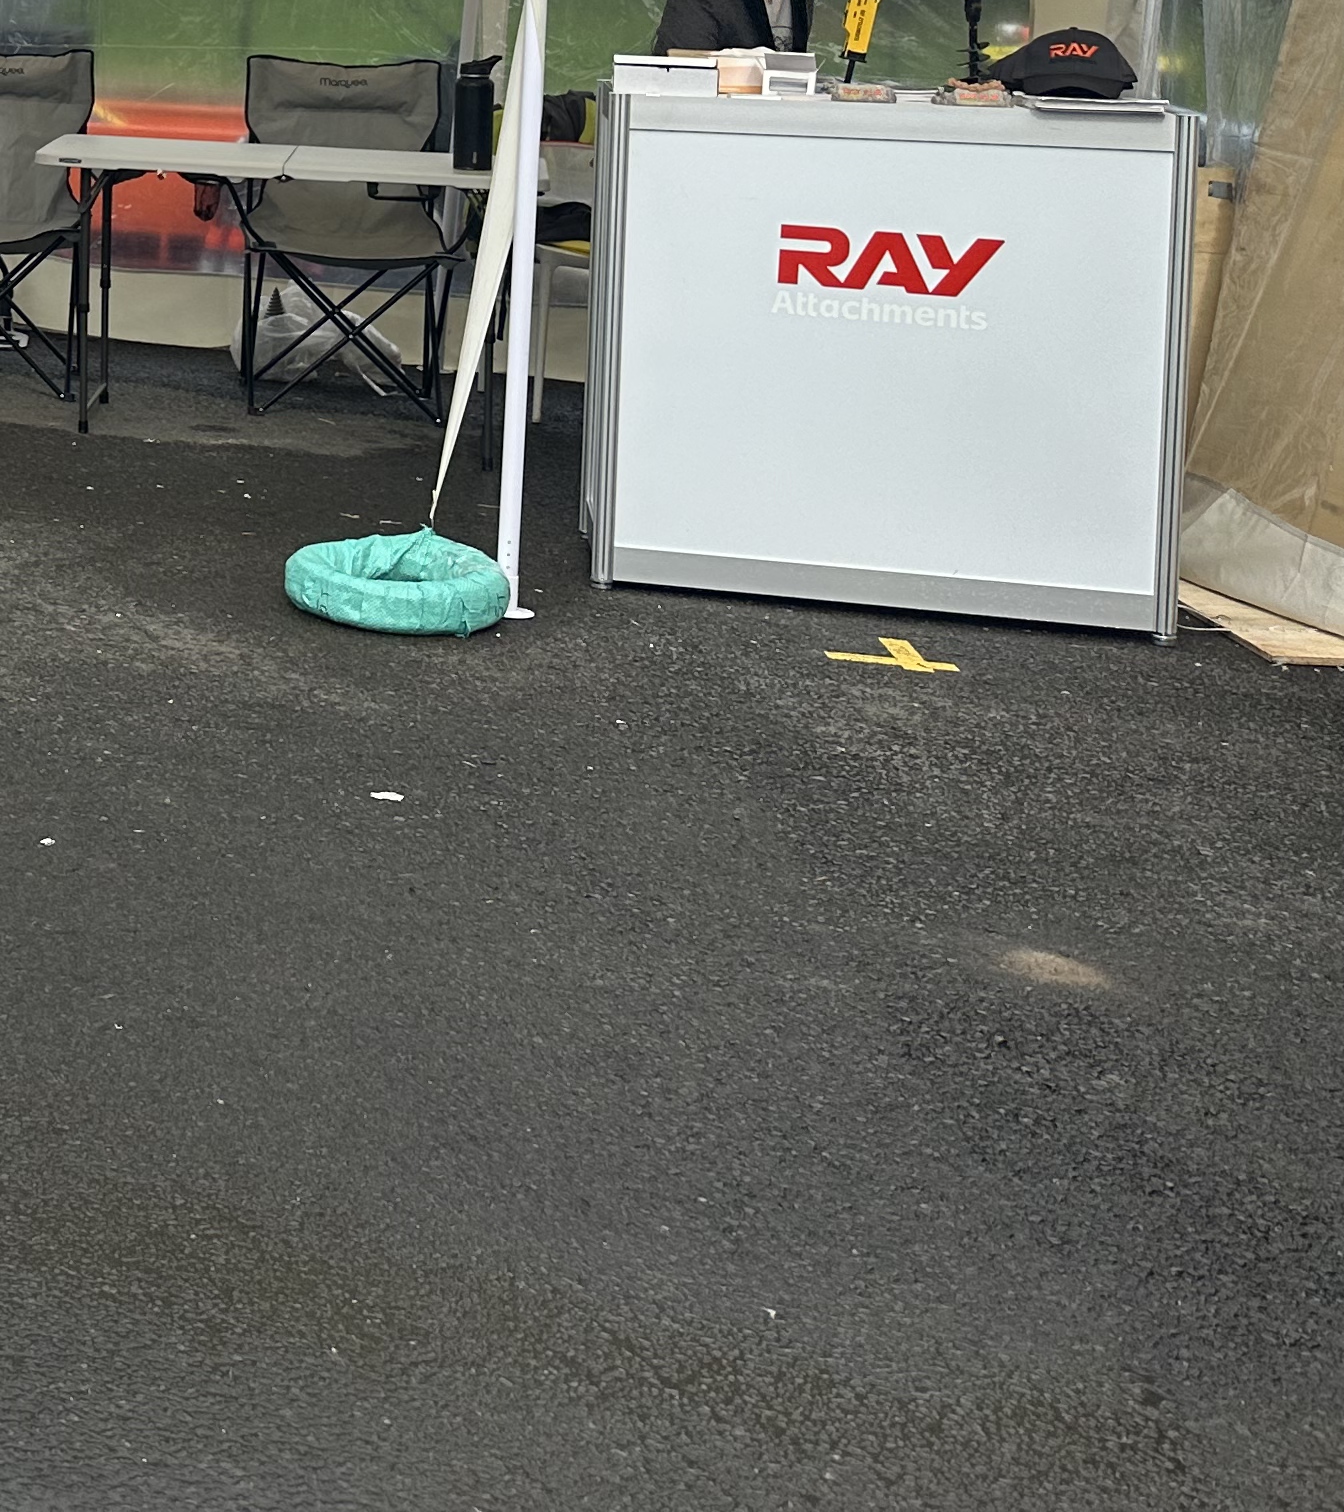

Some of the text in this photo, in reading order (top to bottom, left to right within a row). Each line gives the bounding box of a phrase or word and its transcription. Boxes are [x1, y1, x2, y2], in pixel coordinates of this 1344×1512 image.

[1049, 41, 1100, 58] RAY
[777, 223, 1006, 298] RAY
[770, 289, 989, 331] Attachments
